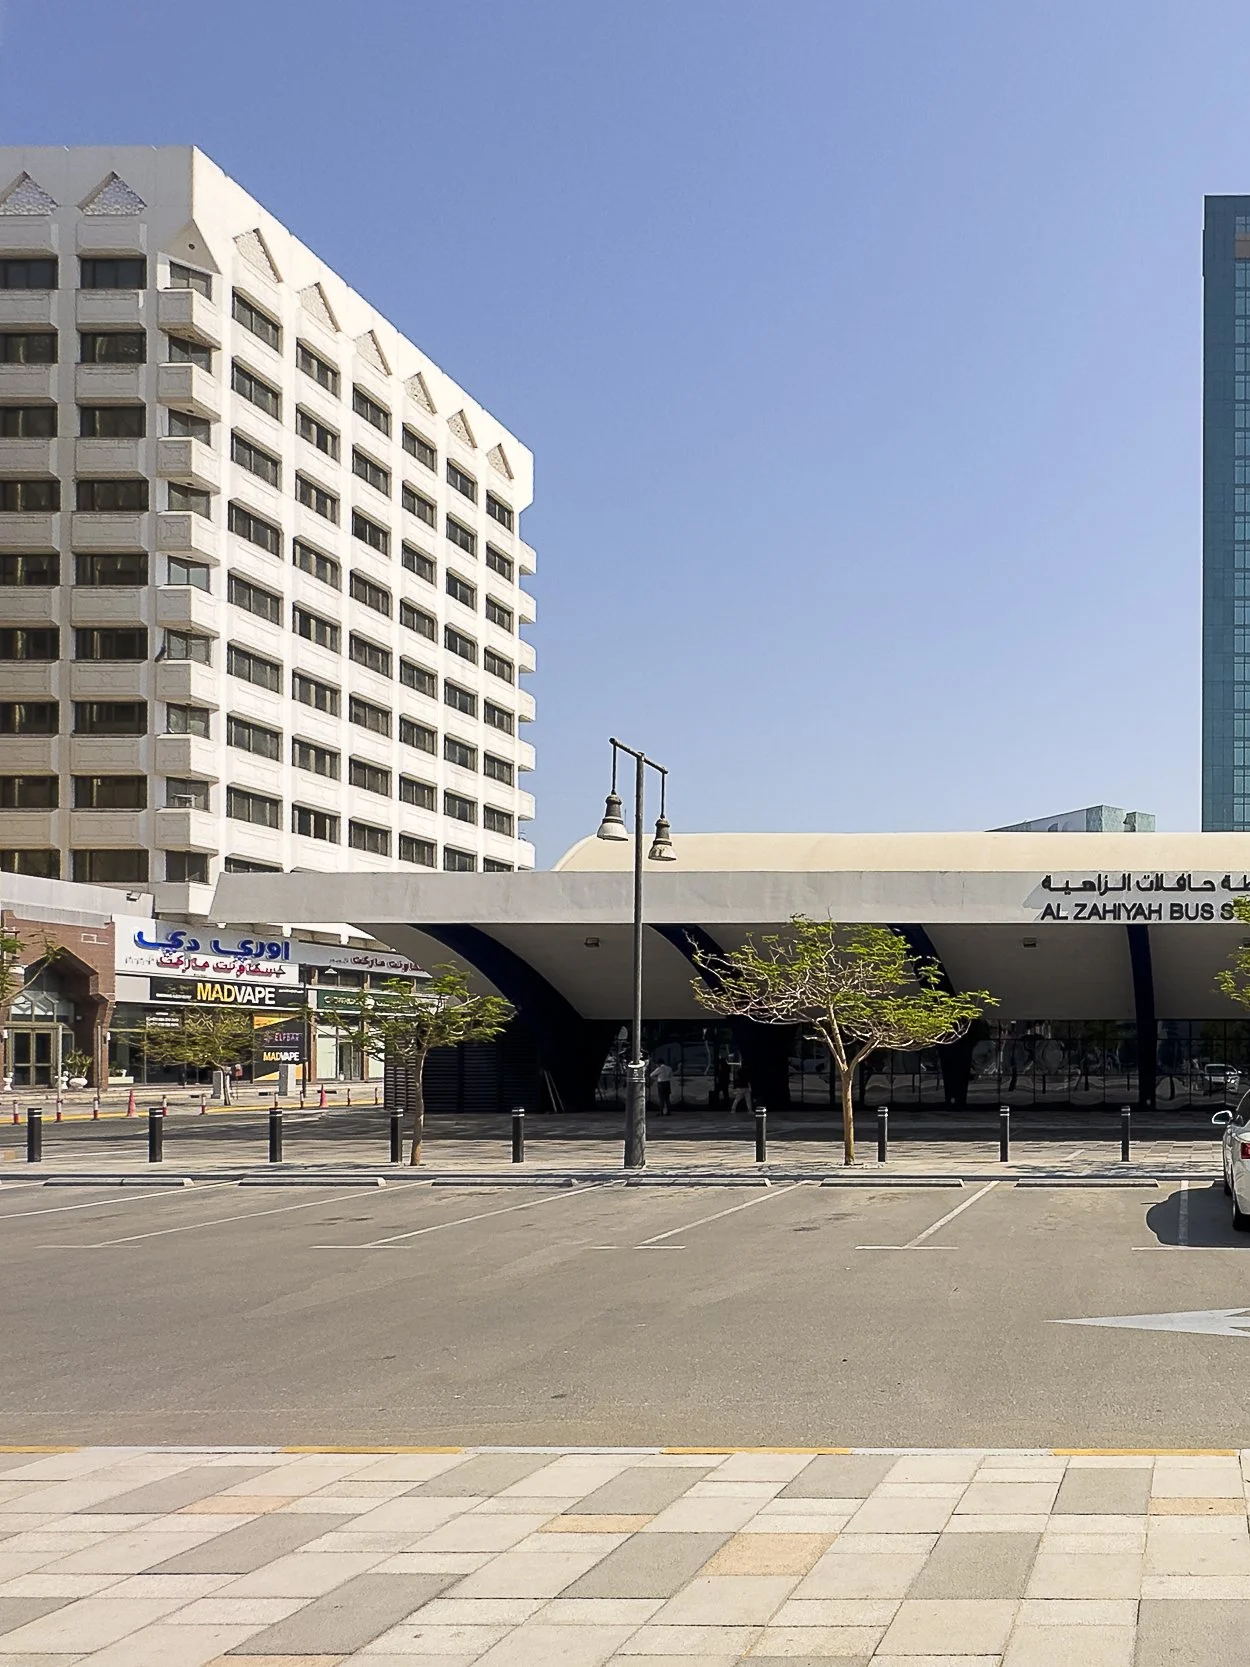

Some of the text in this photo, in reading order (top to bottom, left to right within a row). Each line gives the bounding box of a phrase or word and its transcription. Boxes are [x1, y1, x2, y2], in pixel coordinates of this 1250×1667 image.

[1041, 873, 1132, 896] الزاهية
[1135, 872, 1216, 892] حافلات
[1041, 902, 1069, 921] AL
[1073, 902, 1163, 921] ZAHIYAH
[1169, 902, 1215, 921] BUS
[197, 982, 276, 1005] MADVAPE
[262, 1051, 300, 1062] MADVAPE
